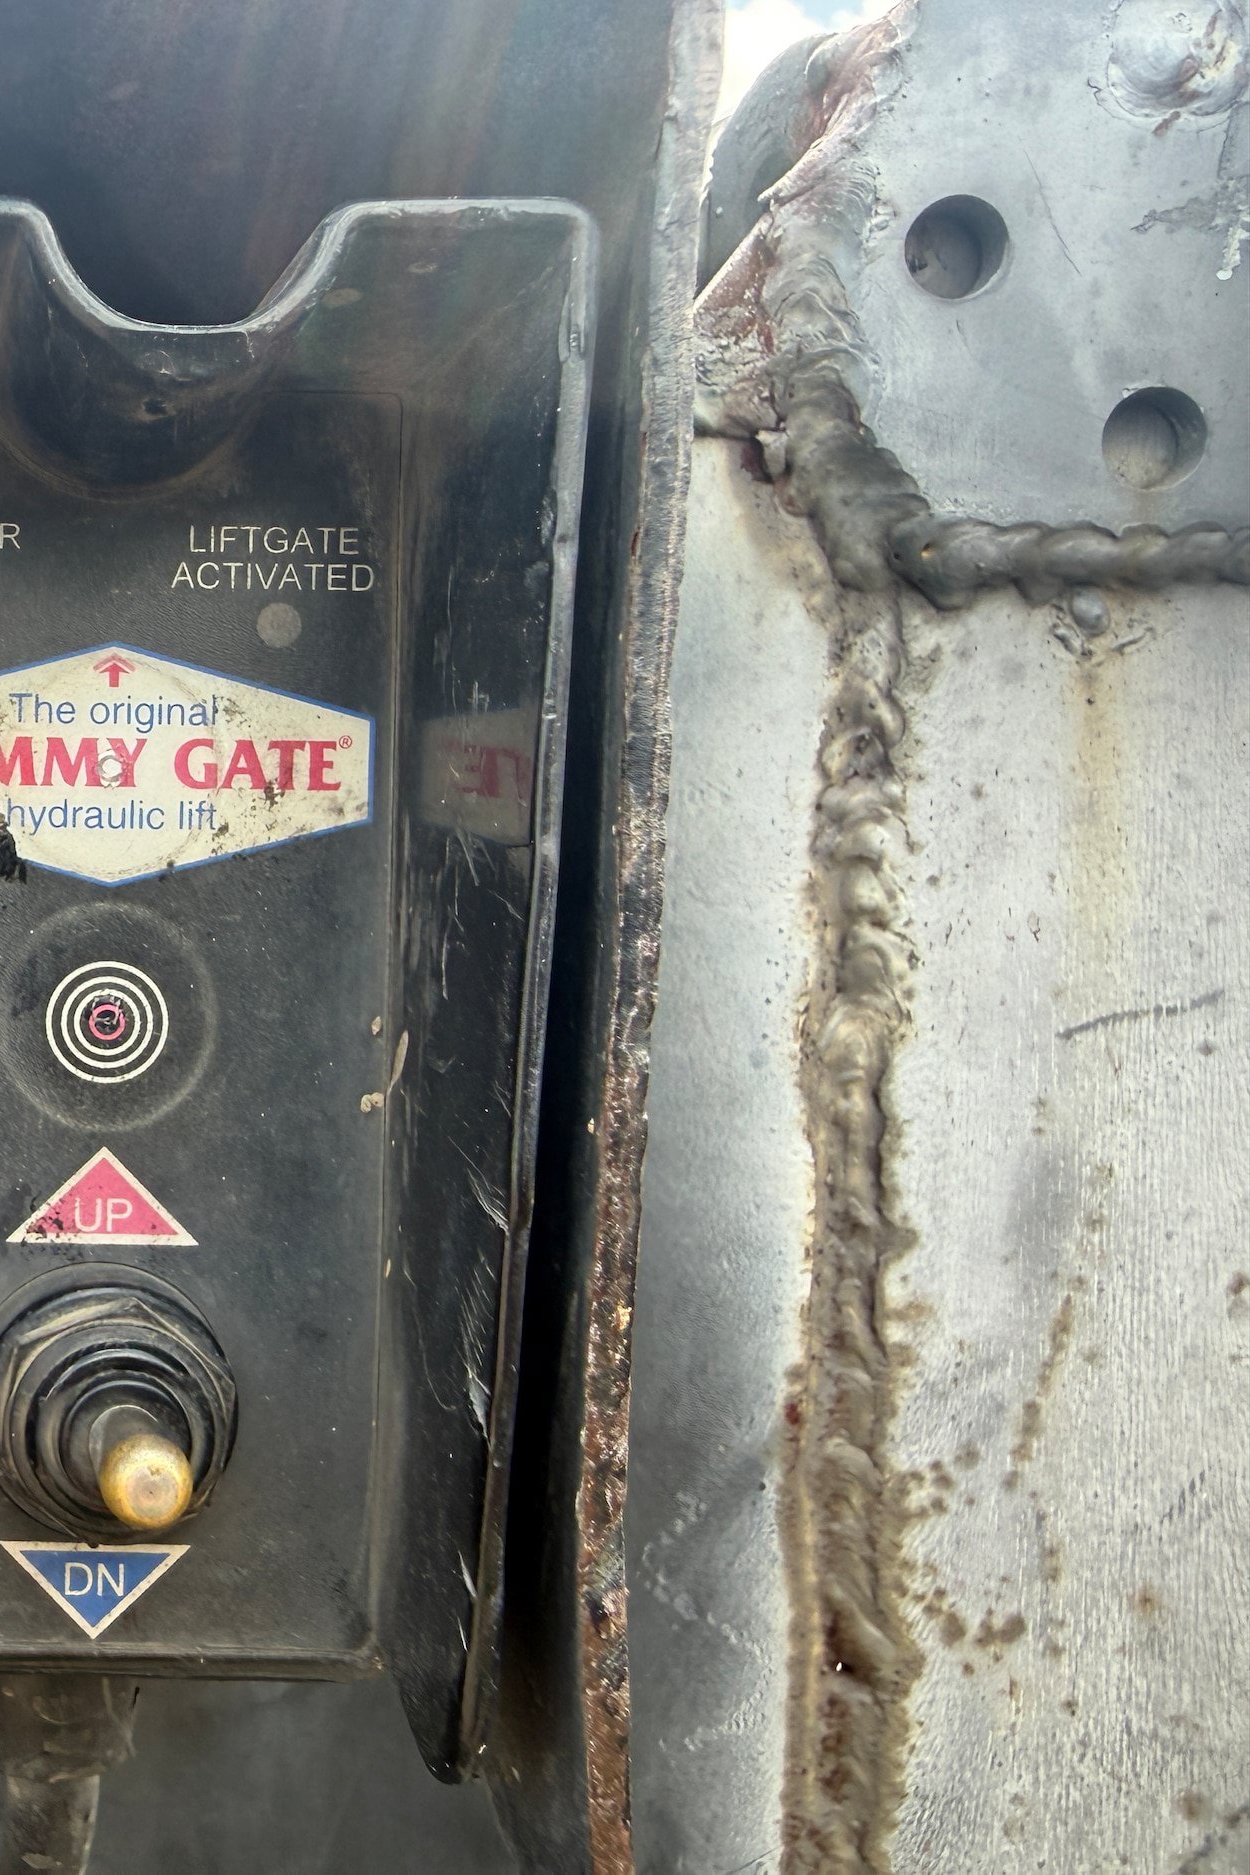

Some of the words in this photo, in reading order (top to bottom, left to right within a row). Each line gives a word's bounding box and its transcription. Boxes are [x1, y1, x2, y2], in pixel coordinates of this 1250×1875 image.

[189, 524, 359, 555] LIFTGATE
[171, 561, 375, 592] ACTIVATED
[9, 692, 76, 724] The
[89, 694, 216, 734] original
[6, 798, 165, 837] hydraulic
[179, 800, 217, 831] lift
[74, 1197, 133, 1232] UP
[64, 1562, 125, 1597] DN
